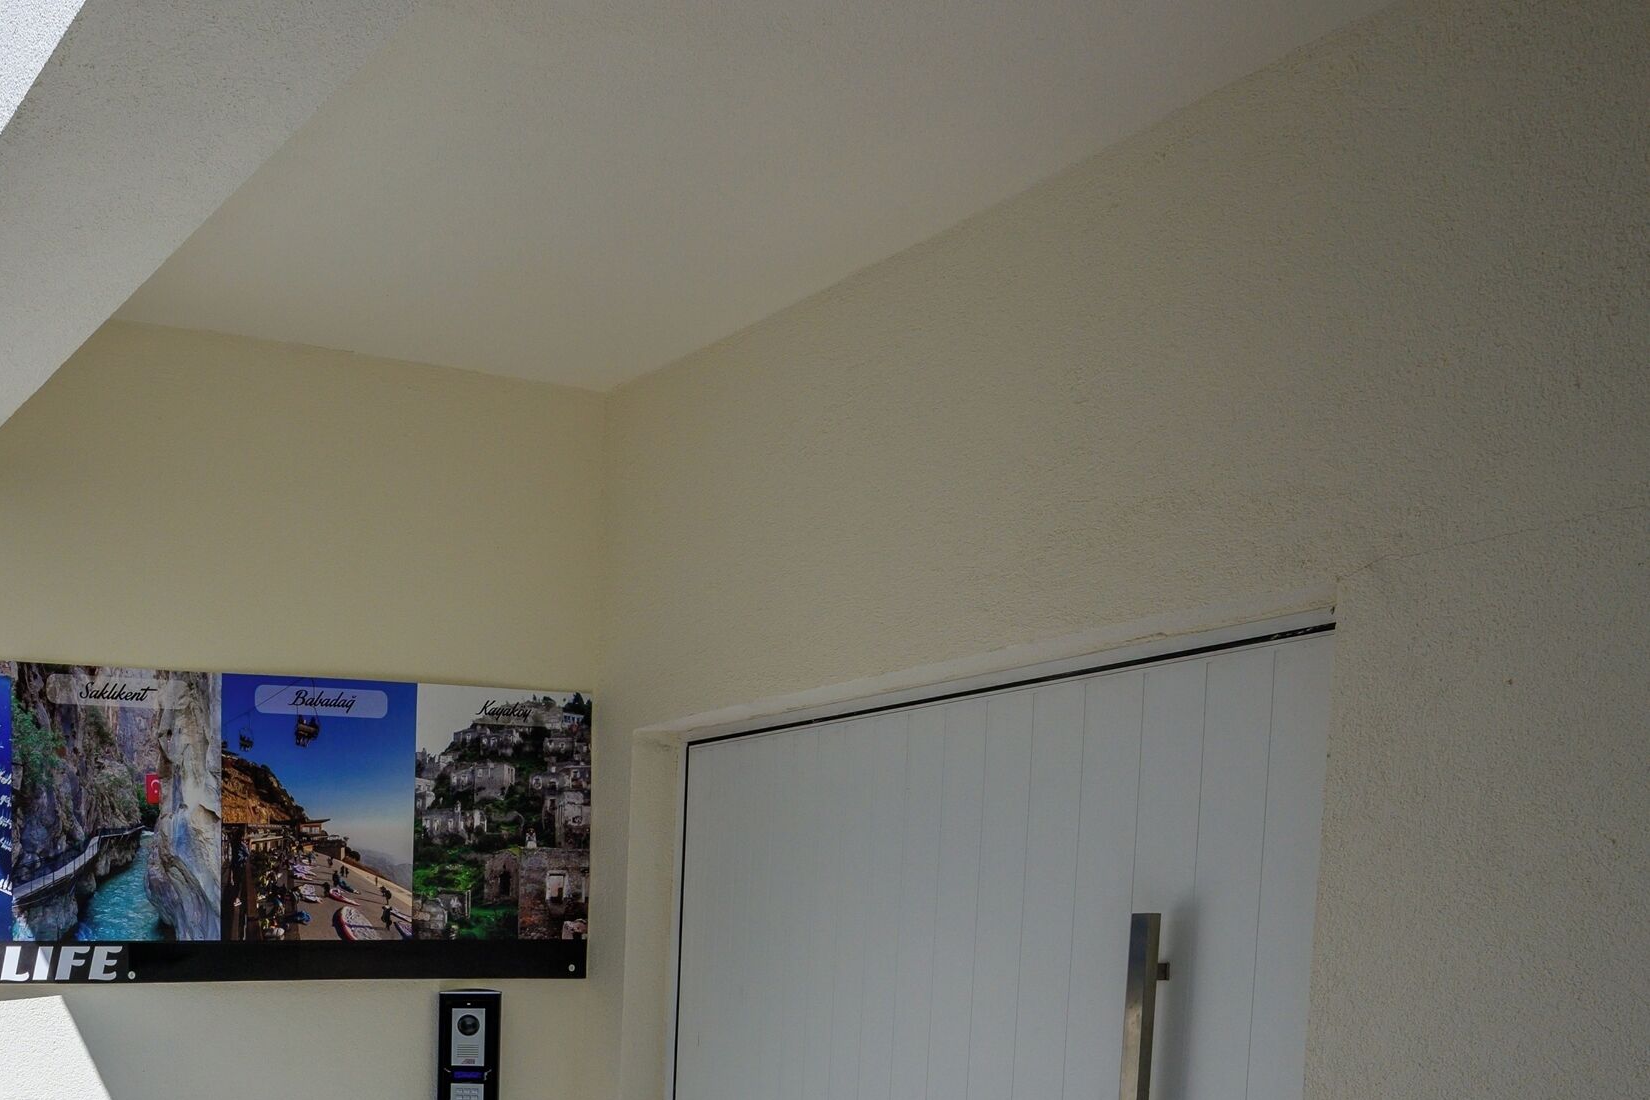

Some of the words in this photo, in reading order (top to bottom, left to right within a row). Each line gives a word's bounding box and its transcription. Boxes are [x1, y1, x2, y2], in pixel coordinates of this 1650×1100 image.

[79, 681, 158, 701] Saklıkent
[288, 689, 357, 714] Babadağ
[476, 699, 533, 722] Kayaköy
